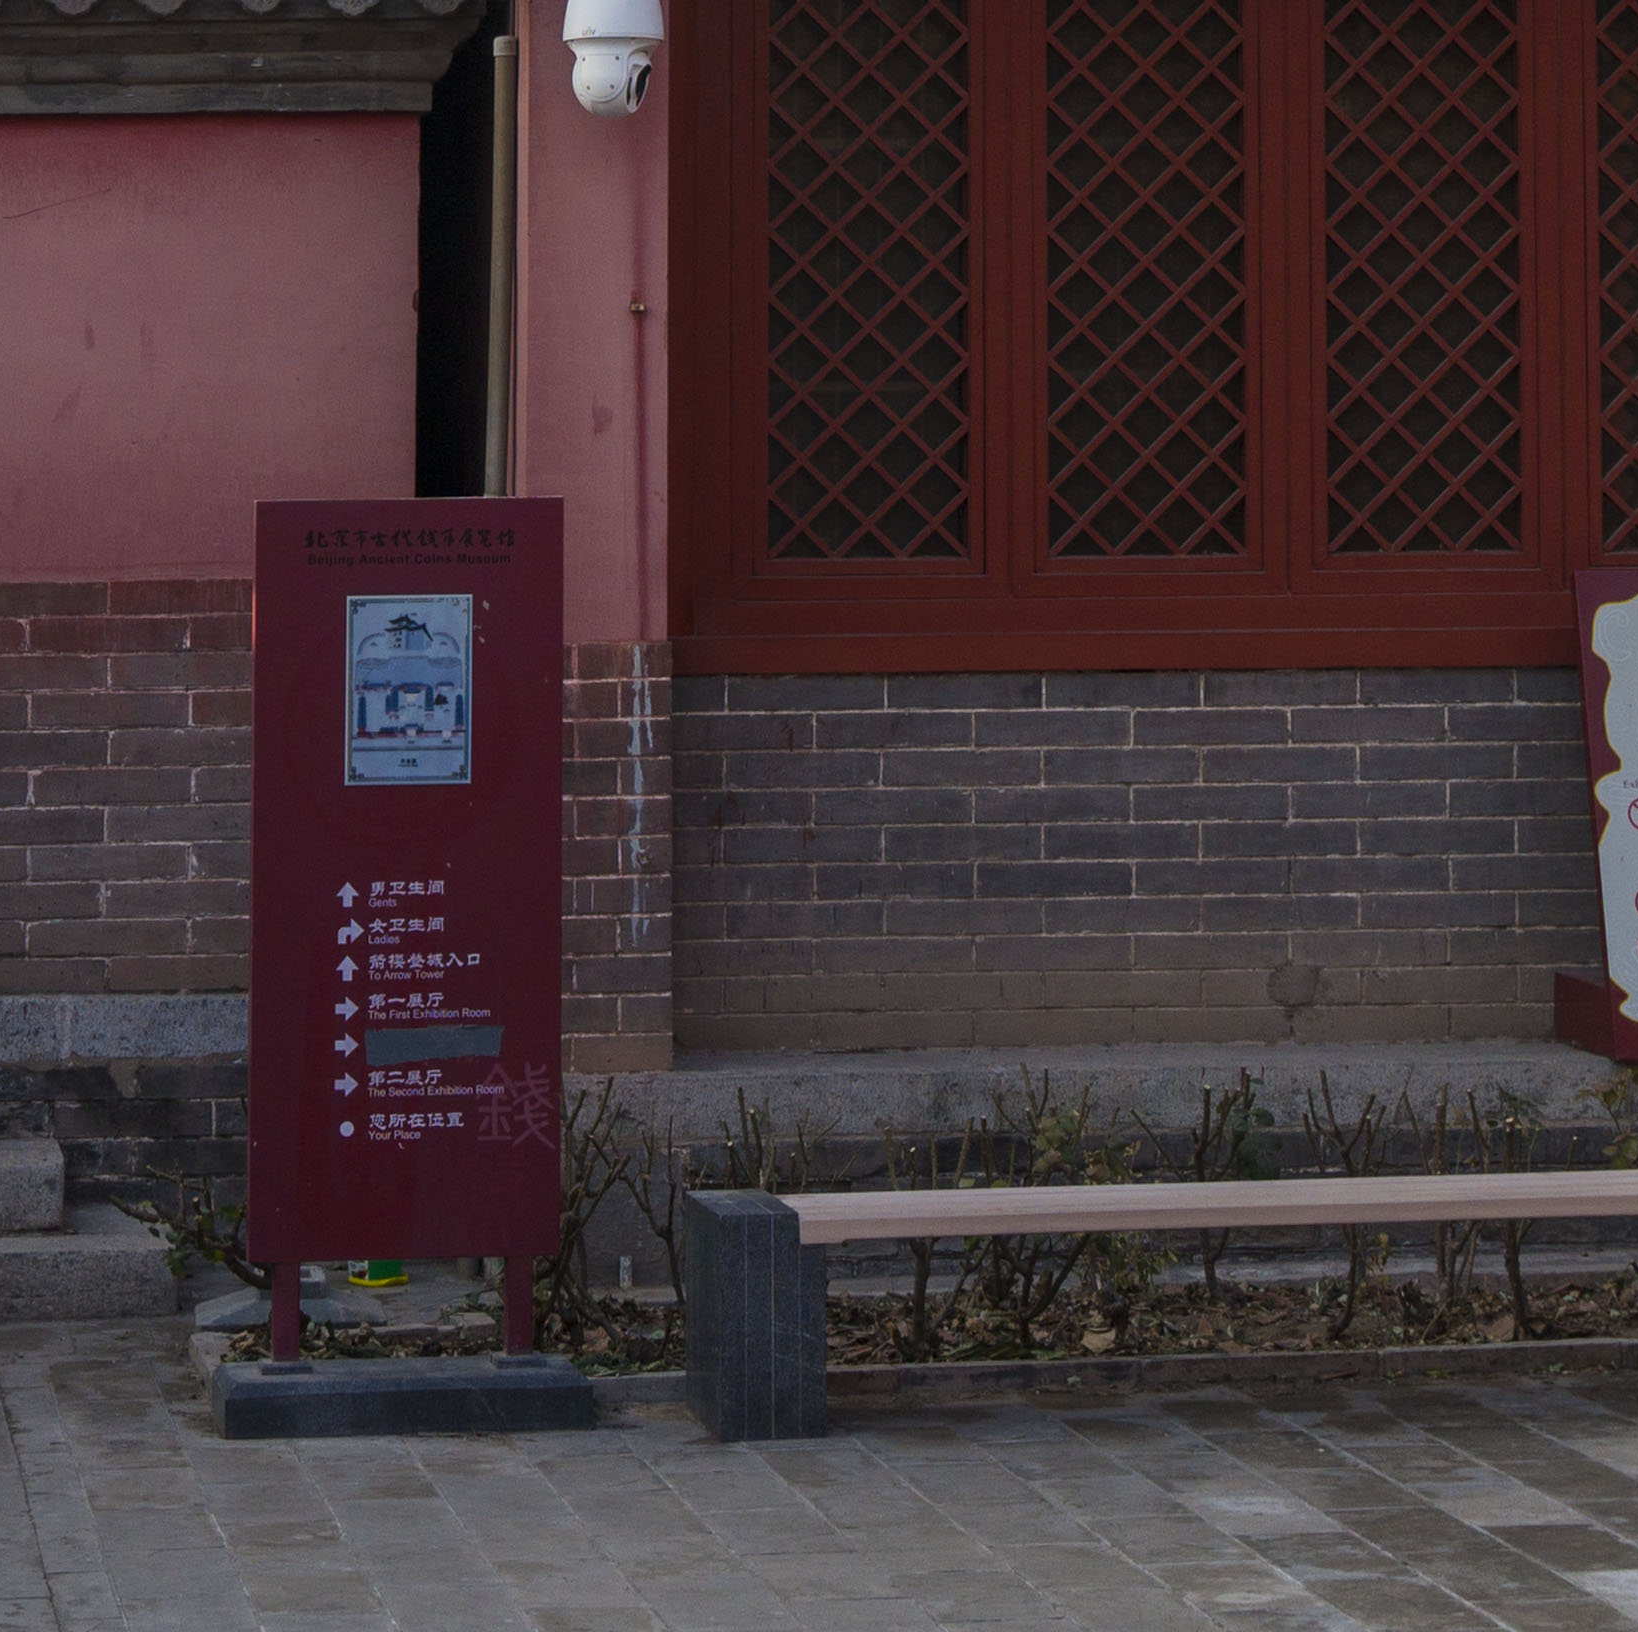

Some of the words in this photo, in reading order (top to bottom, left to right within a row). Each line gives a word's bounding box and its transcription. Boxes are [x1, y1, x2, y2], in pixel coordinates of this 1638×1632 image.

[308, 553, 354, 567] Beijing
[359, 553, 409, 565] Ancient
[414, 553, 451, 565] Coins
[457, 553, 511, 564] Museum
[370, 880, 445, 897] 男卫生间
[368, 898, 397, 908] Gents
[368, 917, 445, 934] 女卫生间
[368, 935, 400, 945] Ladies
[368, 970, 381, 981] To
[383, 970, 411, 980] Arrow
[415, 969, 445, 980] Tower
[368, 992, 444, 1010] 第一展厅
[368, 1010, 386, 1020] The
[389, 1009, 411, 1019] First
[413, 1008, 459, 1019] Exhibition
[462, 1007, 491, 1017] Room
[368, 1069, 442, 1087] 第二展厅
[368, 1087, 386, 1097] The
[388, 1086, 425, 1097] Second
[427, 1085, 473, 1096] Exhibition
[476, 1085, 505, 1095] Room
[369, 1111, 464, 1131] 您所在位置
[368, 1131, 391, 1141] Your
[394, 1130, 421, 1140] Place
